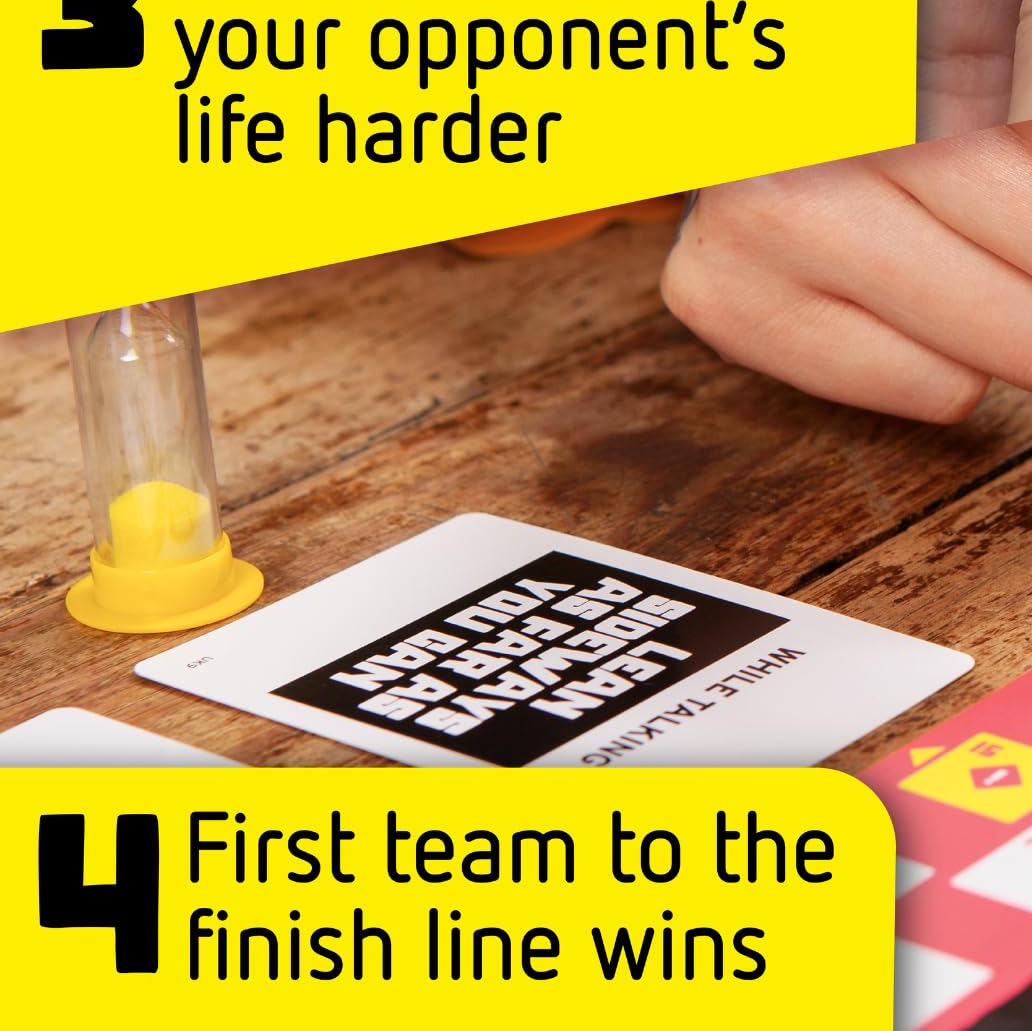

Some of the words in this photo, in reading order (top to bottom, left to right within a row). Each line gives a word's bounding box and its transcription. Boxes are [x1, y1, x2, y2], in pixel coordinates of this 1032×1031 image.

[443, 578, 575, 641] YOU
[550, 576, 643, 621] AS
[329, 629, 452, 692] CAN
[414, 590, 697, 736] SIDEWAYS
[437, 614, 571, 680] FAR
[715, 647, 806, 699] WHILE
[357, 671, 453, 722] AS
[529, 640, 693, 720] LEAN
[582, 694, 716, 766] TALKING
